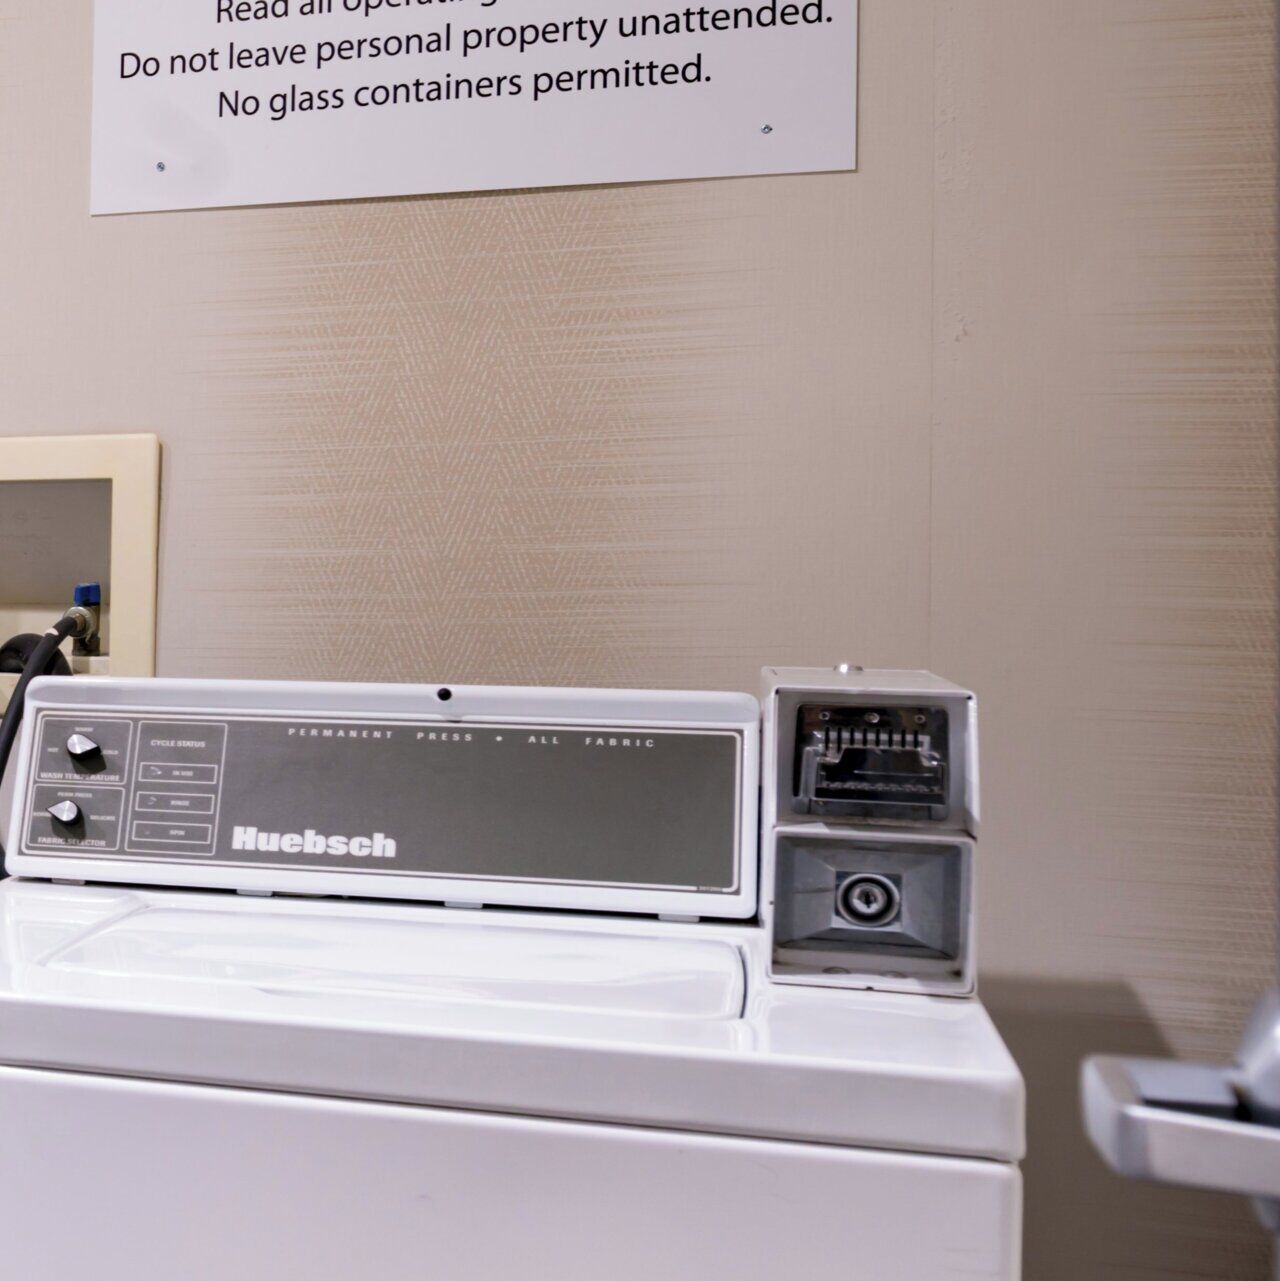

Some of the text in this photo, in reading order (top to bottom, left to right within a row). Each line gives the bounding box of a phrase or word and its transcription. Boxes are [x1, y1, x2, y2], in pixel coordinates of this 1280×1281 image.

[217, 0, 289, 23] Read
[120, 0, 833, 79] Do not leave personal property unattended.
[218, 53, 712, 121] No glass containers permitted.
[150, 739, 206, 748] CYCLE STATUS
[288, 727, 656, 748] PERMANENT PRESS ALL FABRIC
[232, 826, 397, 858] Huebsch
